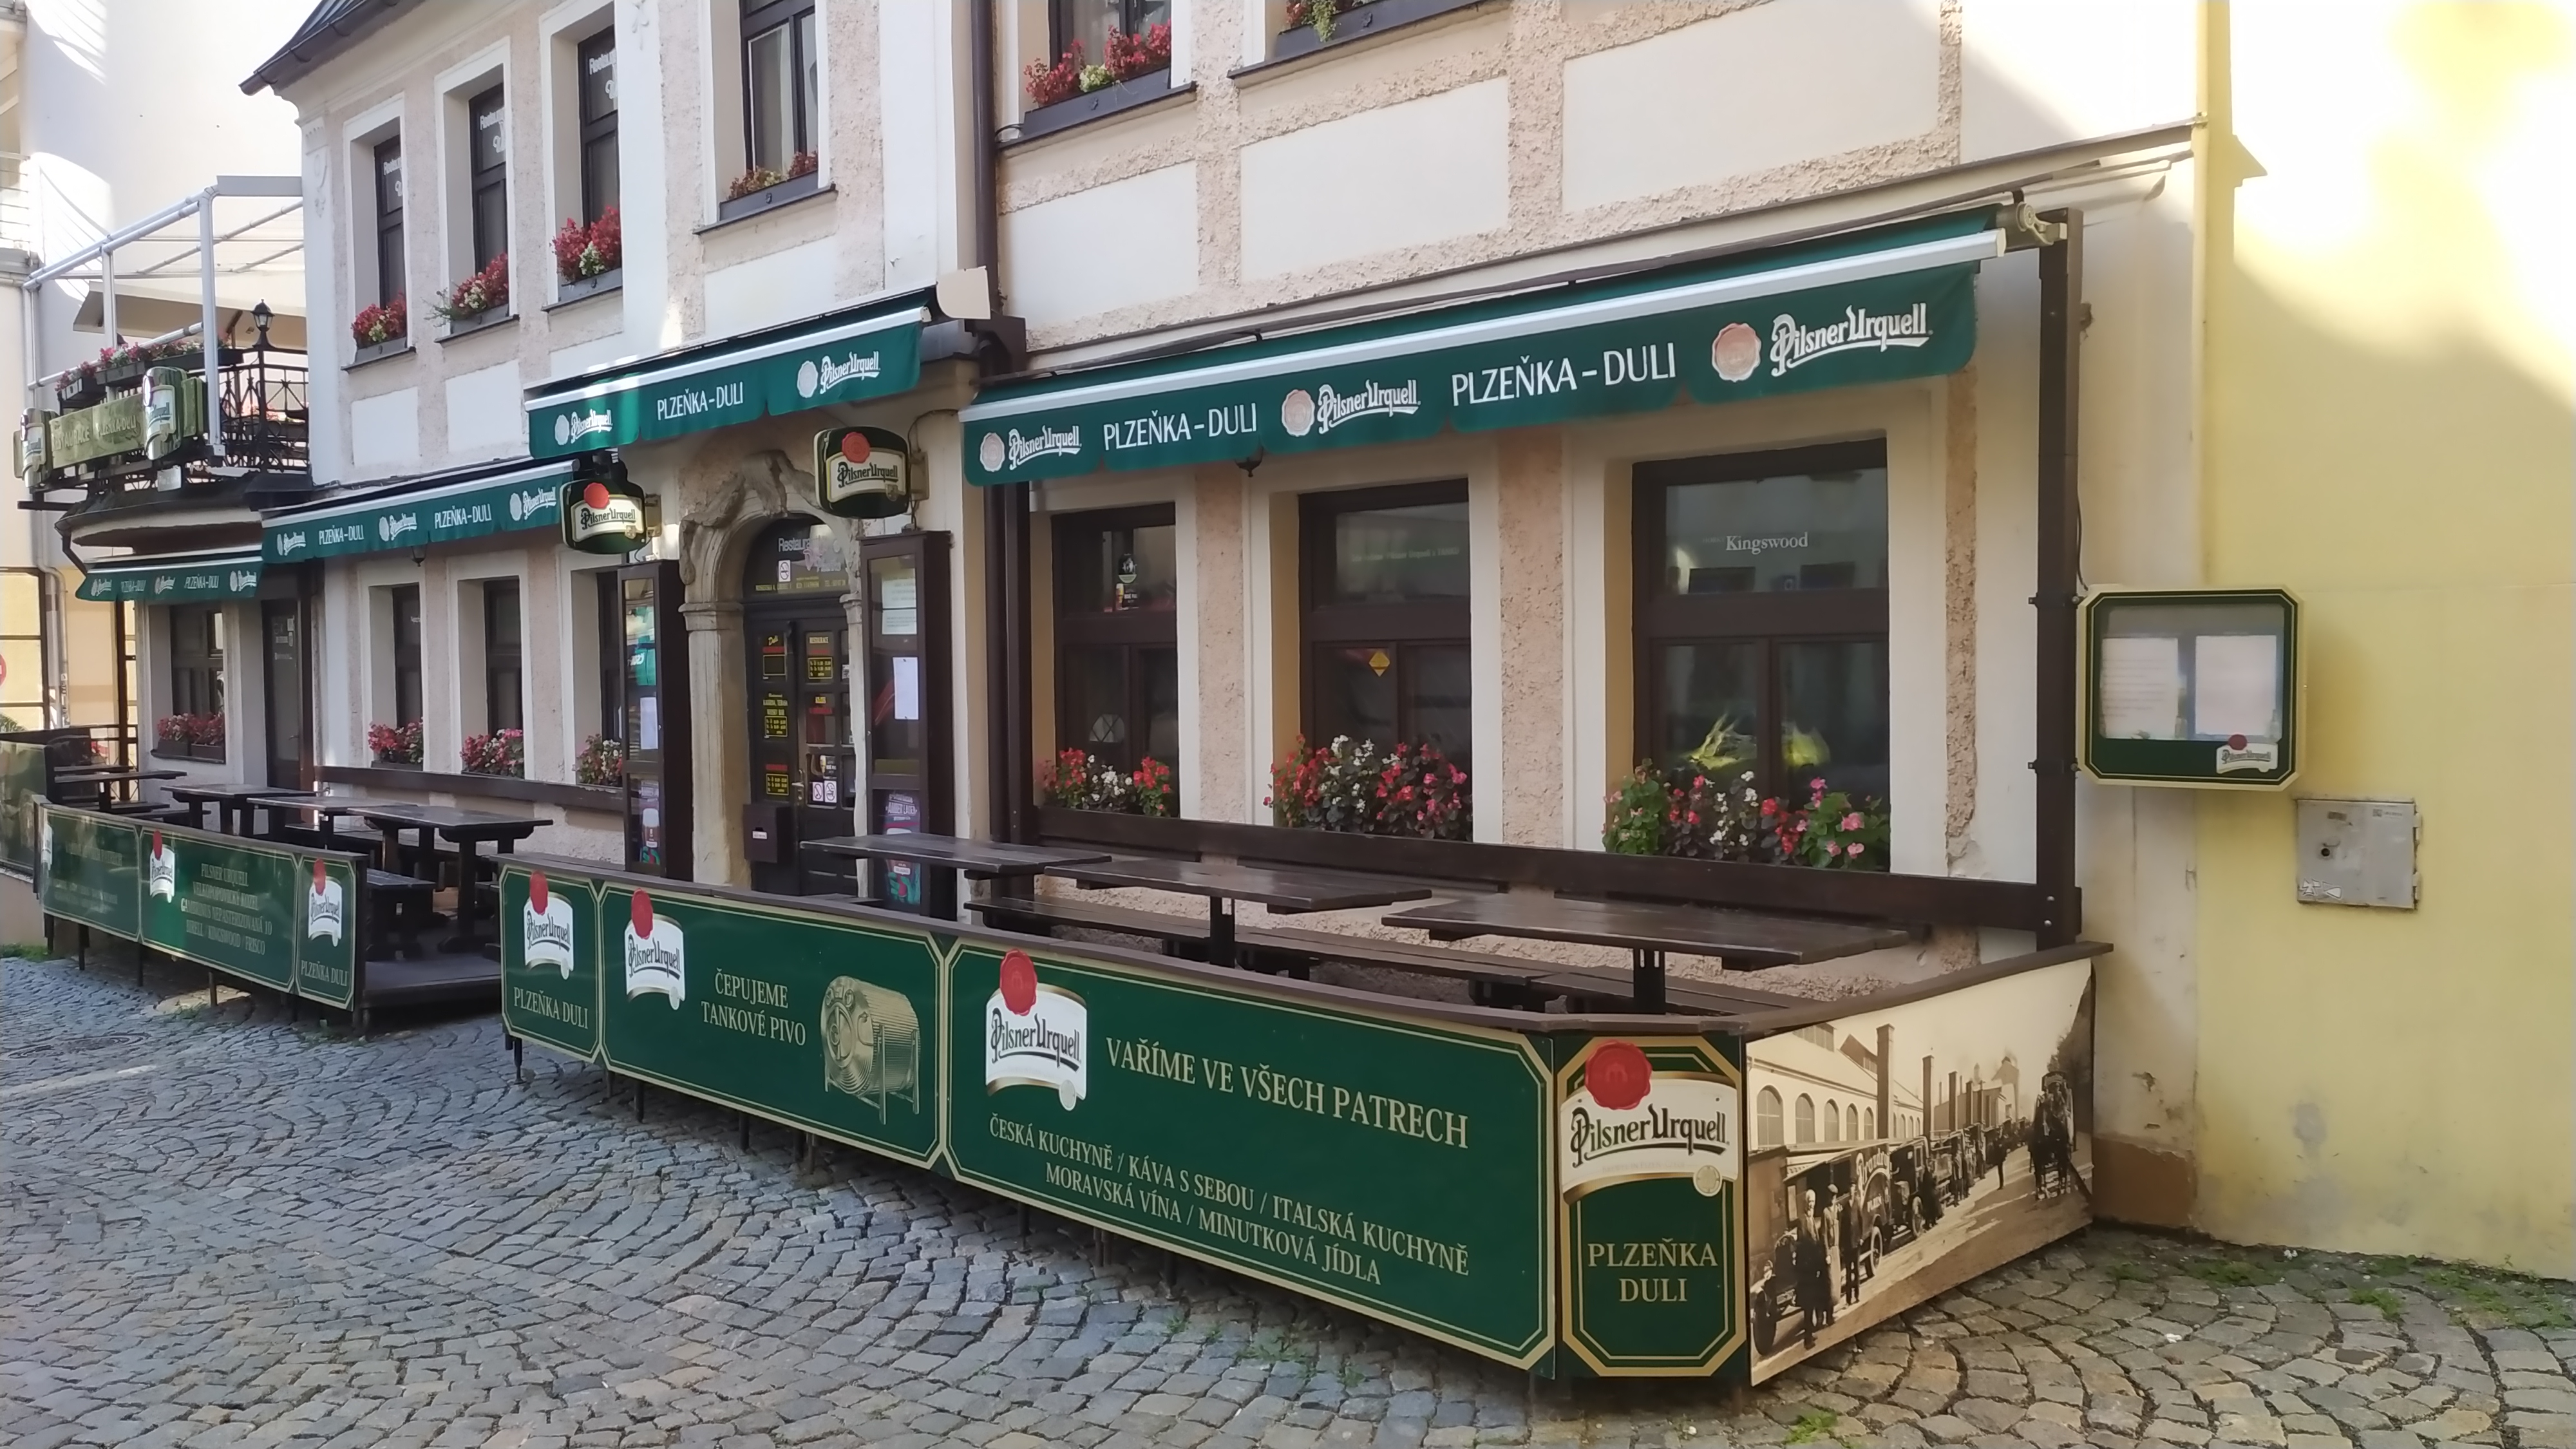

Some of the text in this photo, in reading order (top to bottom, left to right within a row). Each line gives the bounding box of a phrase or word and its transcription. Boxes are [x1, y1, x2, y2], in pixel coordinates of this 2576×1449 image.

[1770, 303, 1927, 378] Pilsner Urquell
[820, 351, 879, 395] Pilsner Urquell
[1317, 379, 1417, 435] Pilsner Urquell
[1008, 425, 1080, 470] Pilsner Urquell
[837, 461, 898, 488] Pilsner Urquell
[581, 507, 636, 531] Pilsner Urquell
[1726, 532, 1808, 555] Kingswood
[527, 909, 571, 950] Pilsner Urquell
[330, 967, 349, 987] DULI
[628, 934, 681, 978] Pilsner Urquell
[513, 985, 589, 1030] PLZEŇKA DULI
[715, 968, 789, 1009] ČEPUJEME
[701, 1001, 806, 1046] TANKOVÉ PIVO
[990, 1006, 1082, 1068] Pilsner Urquell
[1106, 1037, 1469, 1149] VAŘÍME VE VŠECH PATRECH
[1570, 1103, 1728, 1170] Pilsner Urquell
[990, 1112, 1034, 1148] ČESKÁ
[1038, 1131, 1113, 1173] KUCHYNĚ
[1128, 1153, 1175, 1189] KÁVA
[1180, 1168, 1190, 1192] S
[1194, 1172, 1255, 1211] SEBOU
[1273, 1195, 1356, 1243] ITALSKÁ
[1363, 1213, 1470, 1276] KUCHYNĚ
[1046, 1162, 1135, 1210] MORAVSKÁ
[1139, 1189, 1182, 1225] VÍNA
[1198, 1206, 1318, 1266] MINUTKOVÁ
[1322, 1243, 1381, 1287] JÍDLA
[1588, 1237, 1718, 1267] PLZEŇKA
[1619, 1278, 1687, 1302] DULI
